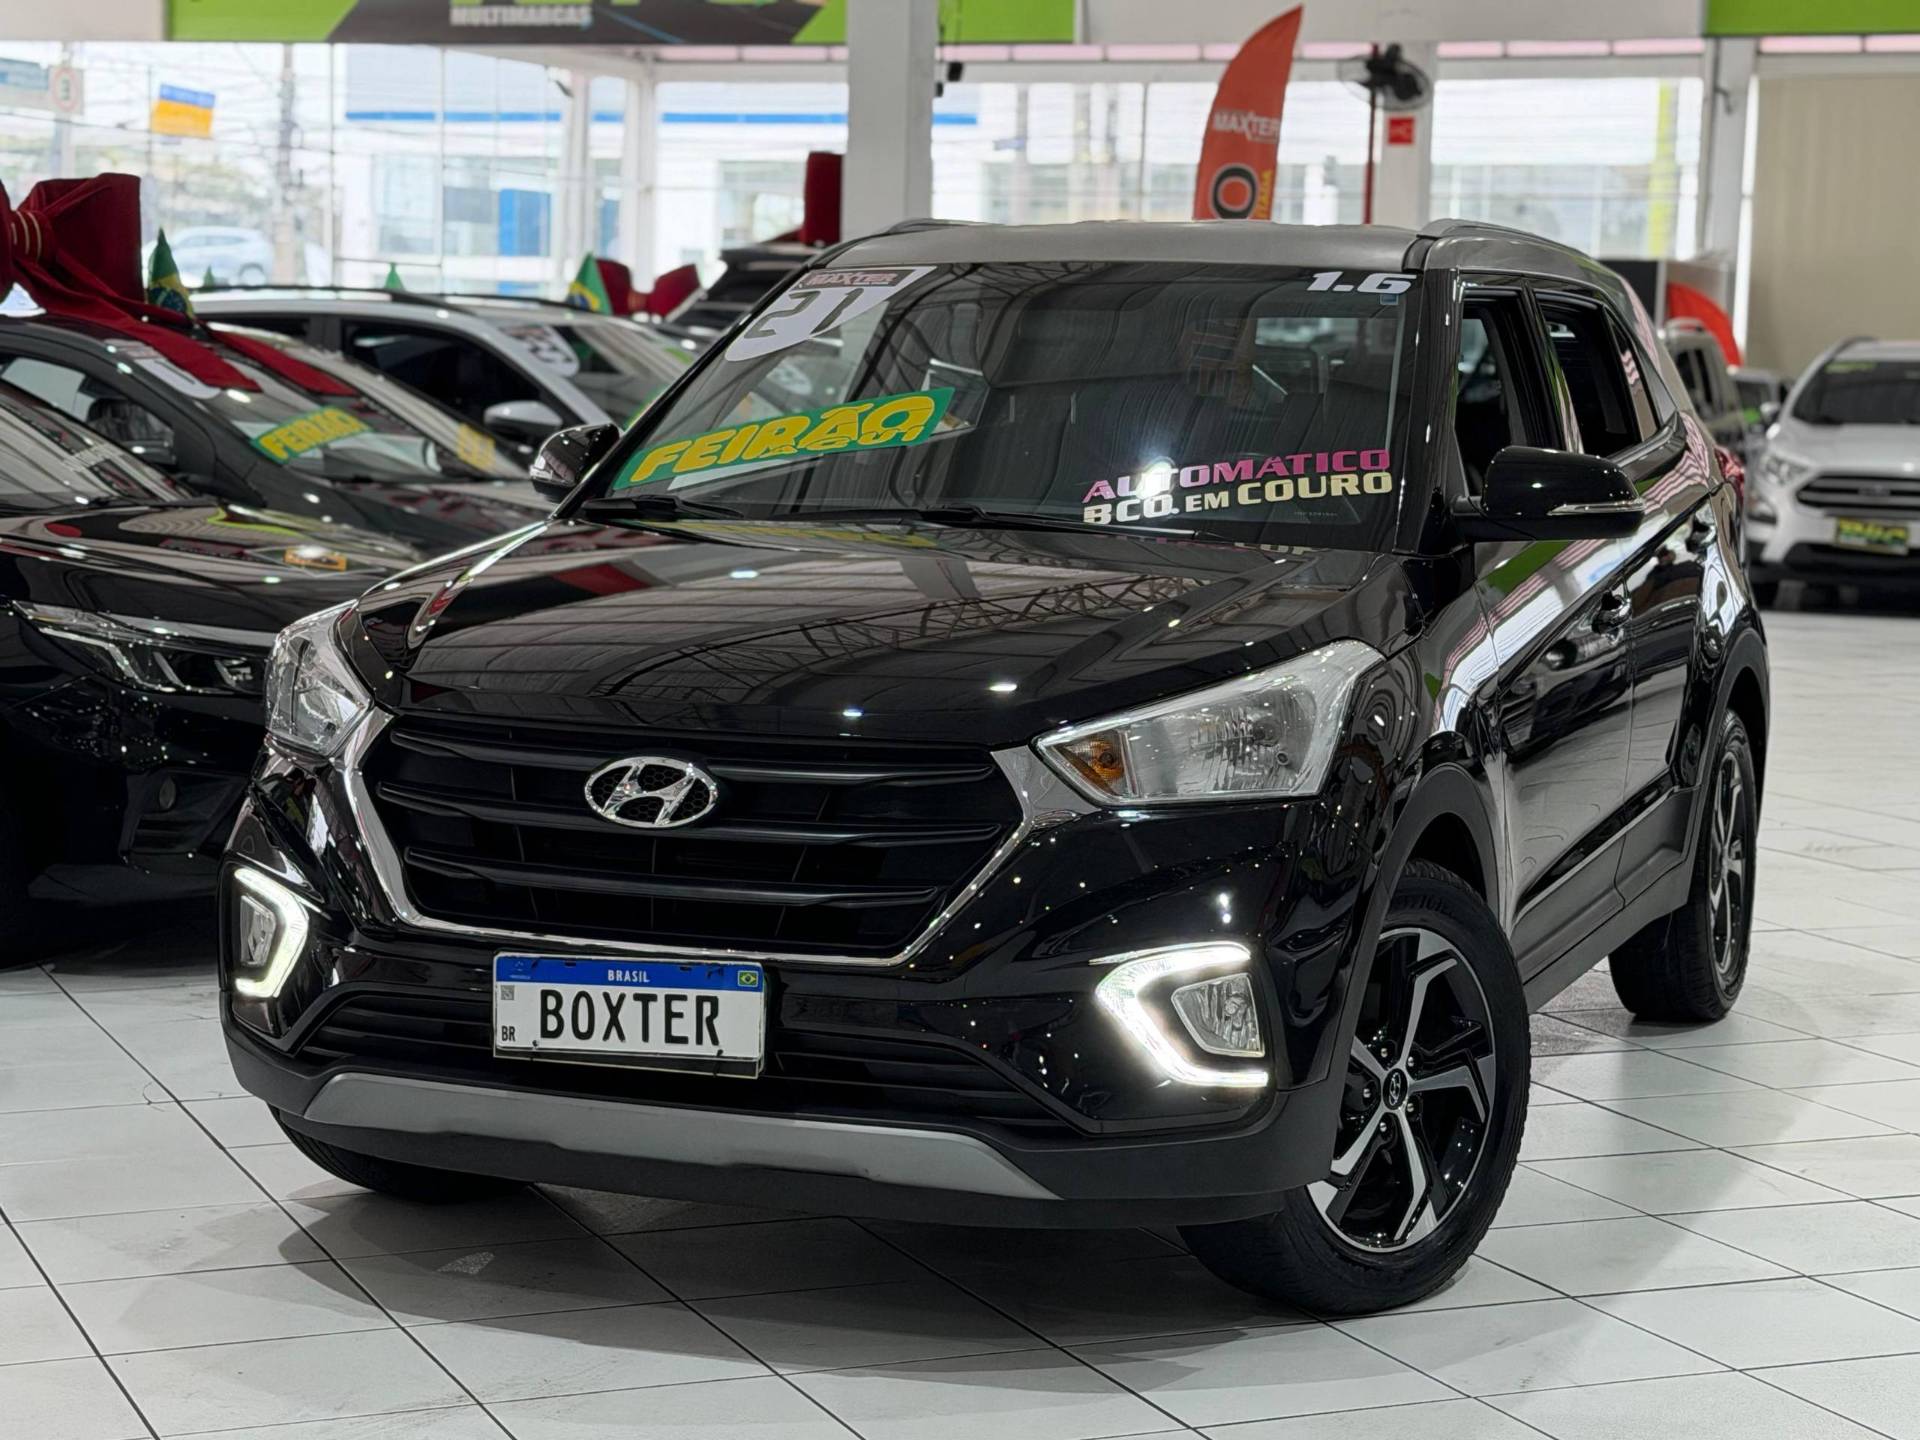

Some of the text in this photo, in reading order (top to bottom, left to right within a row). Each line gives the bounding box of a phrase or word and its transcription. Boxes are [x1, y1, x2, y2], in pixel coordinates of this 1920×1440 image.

[450, 5, 592, 27] MULTIMARCAS
[1307, 271, 1417, 295] 1.6
[743, 288, 865, 339] 21
[630, 396, 935, 483] FEIRÃO
[1083, 472, 1393, 525] BCO. EM COURO
[608, 969, 651, 983] BRASIL
[501, 1025, 516, 1042] BR
[540, 989, 720, 1047] BOXTER
